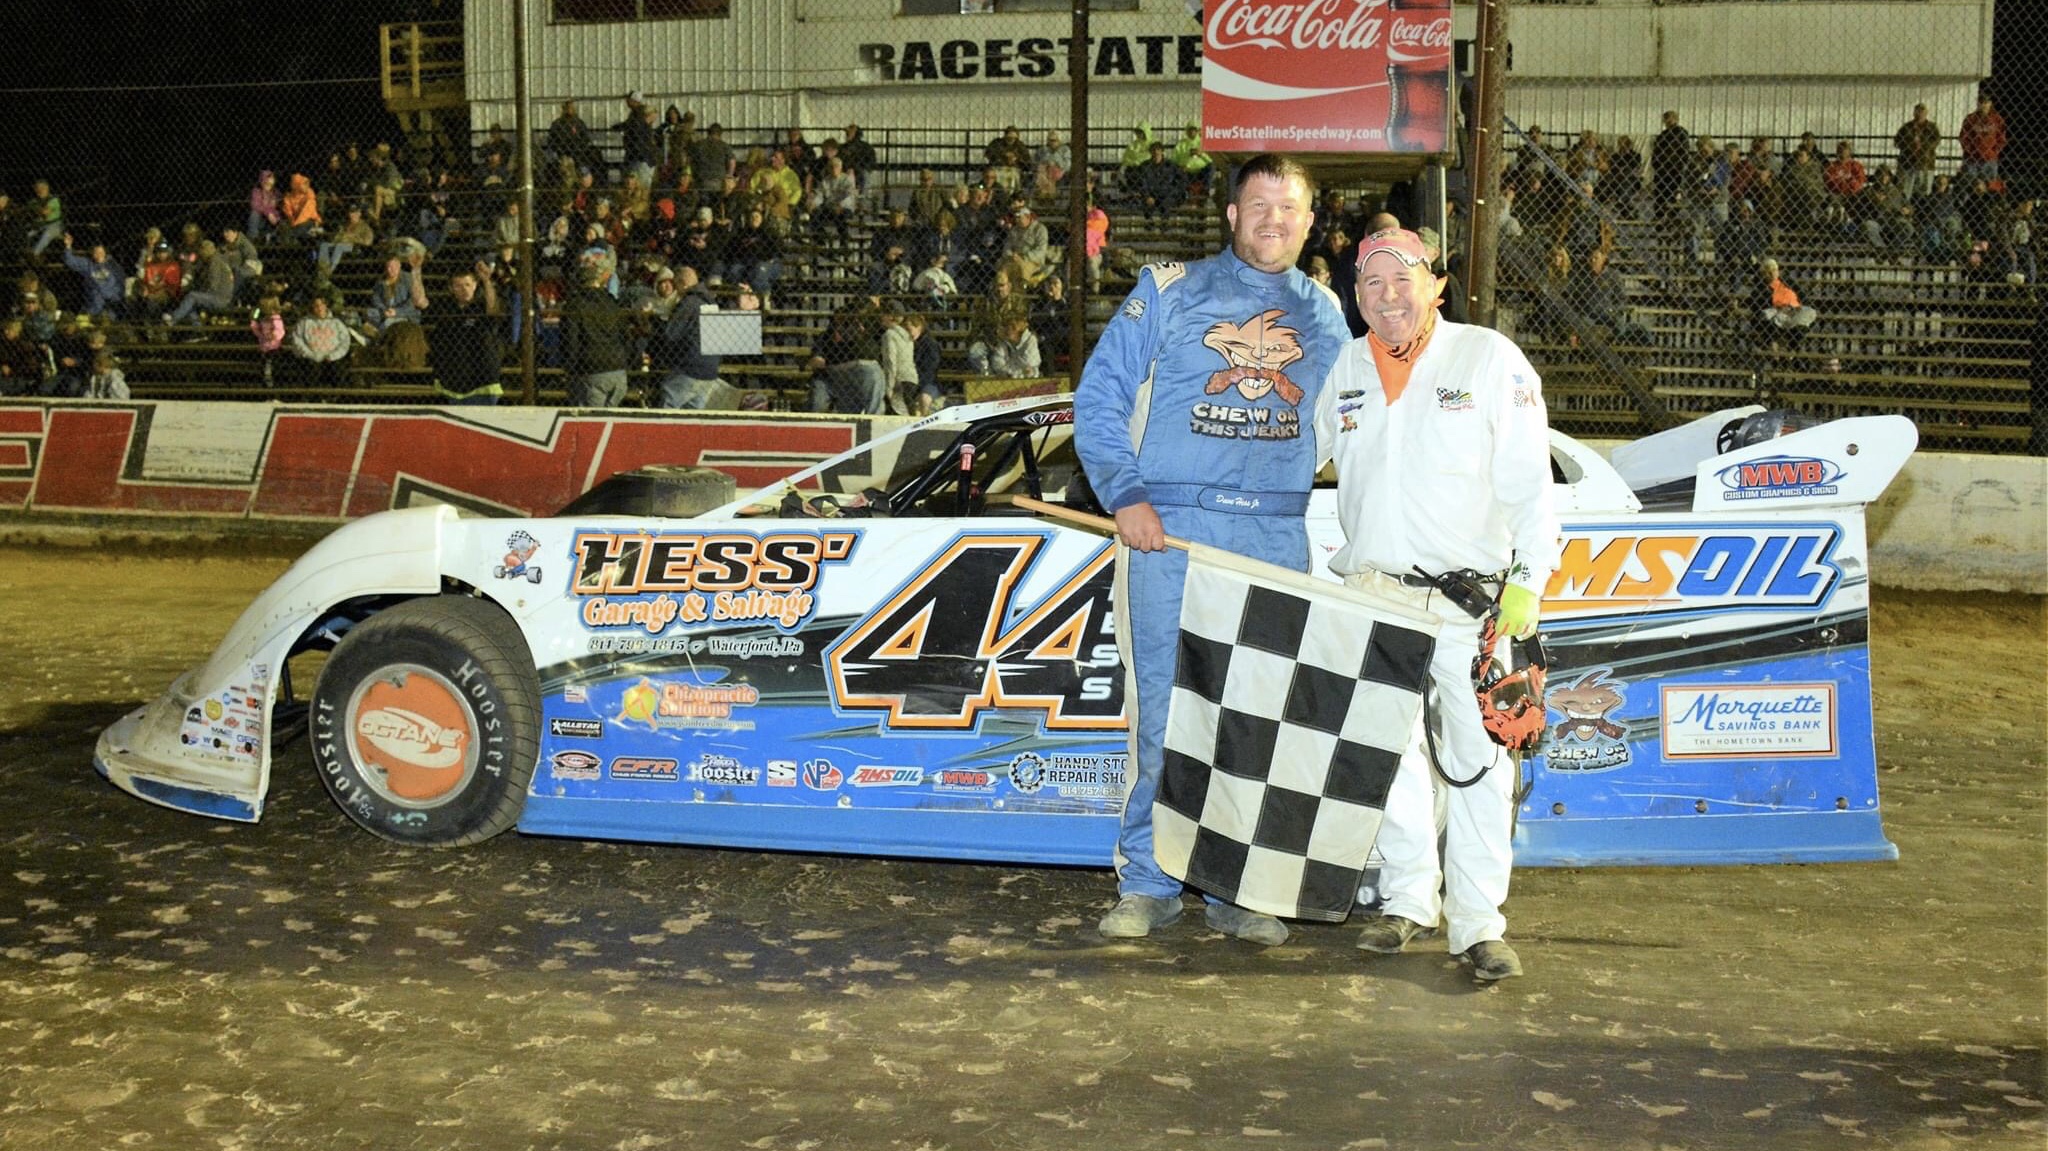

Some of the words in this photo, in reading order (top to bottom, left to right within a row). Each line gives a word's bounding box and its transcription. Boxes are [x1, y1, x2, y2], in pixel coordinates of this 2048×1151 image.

[1207, 0, 1383, 50] Coca-Cola
[1205, 125, 1383, 143] NewStatelineSpeedway.com
[1191, 401, 1271, 425] CHEW
[1275, 408, 1299, 425] ON
[1190, 419, 1238, 439] THIS
[1239, 423, 1300, 441] JERKY
[0, 402, 872, 516] LINE
[1739, 461, 1823, 487] MWB
[1723, 490, 1760, 501] CUSTOM
[1760, 488, 1802, 499] GRAPHICS
[1811, 485, 1838, 496] SIGNS
[571, 533, 857, 595] HESS'
[1541, 537, 1824, 597] MSOIL
[584, 595, 678, 633] Garage
[679, 591, 708, 623] &
[712, 587, 813, 628] Salvage
[826, 533, 1128, 730] 44
[710, 637, 780, 659] Waterford,
[782, 638, 801, 653] Pa
[662, 683, 757, 703] Chiropractic
[451, 658, 508, 779] Hoosier
[658, 700, 730, 718] Solutions
[1673, 693, 1824, 731] Marquette
[560, 721, 601, 731] ALLSTAR
[1718, 720, 1777, 732] SAVINGS
[1783, 720, 1822, 731] BANK
[1546, 746, 1600, 761] CHEW
[1604, 742, 1626, 756] ON
[1693, 738, 1711, 746] THE
[686, 763, 760, 781] Hoosier
[1053, 757, 1099, 770] HANDY
[803, 760, 832, 789] VP
[853, 767, 920, 783] AMSOIL
[943, 771, 989, 785] MWB
[1049, 770, 1098, 783] REPAIR
